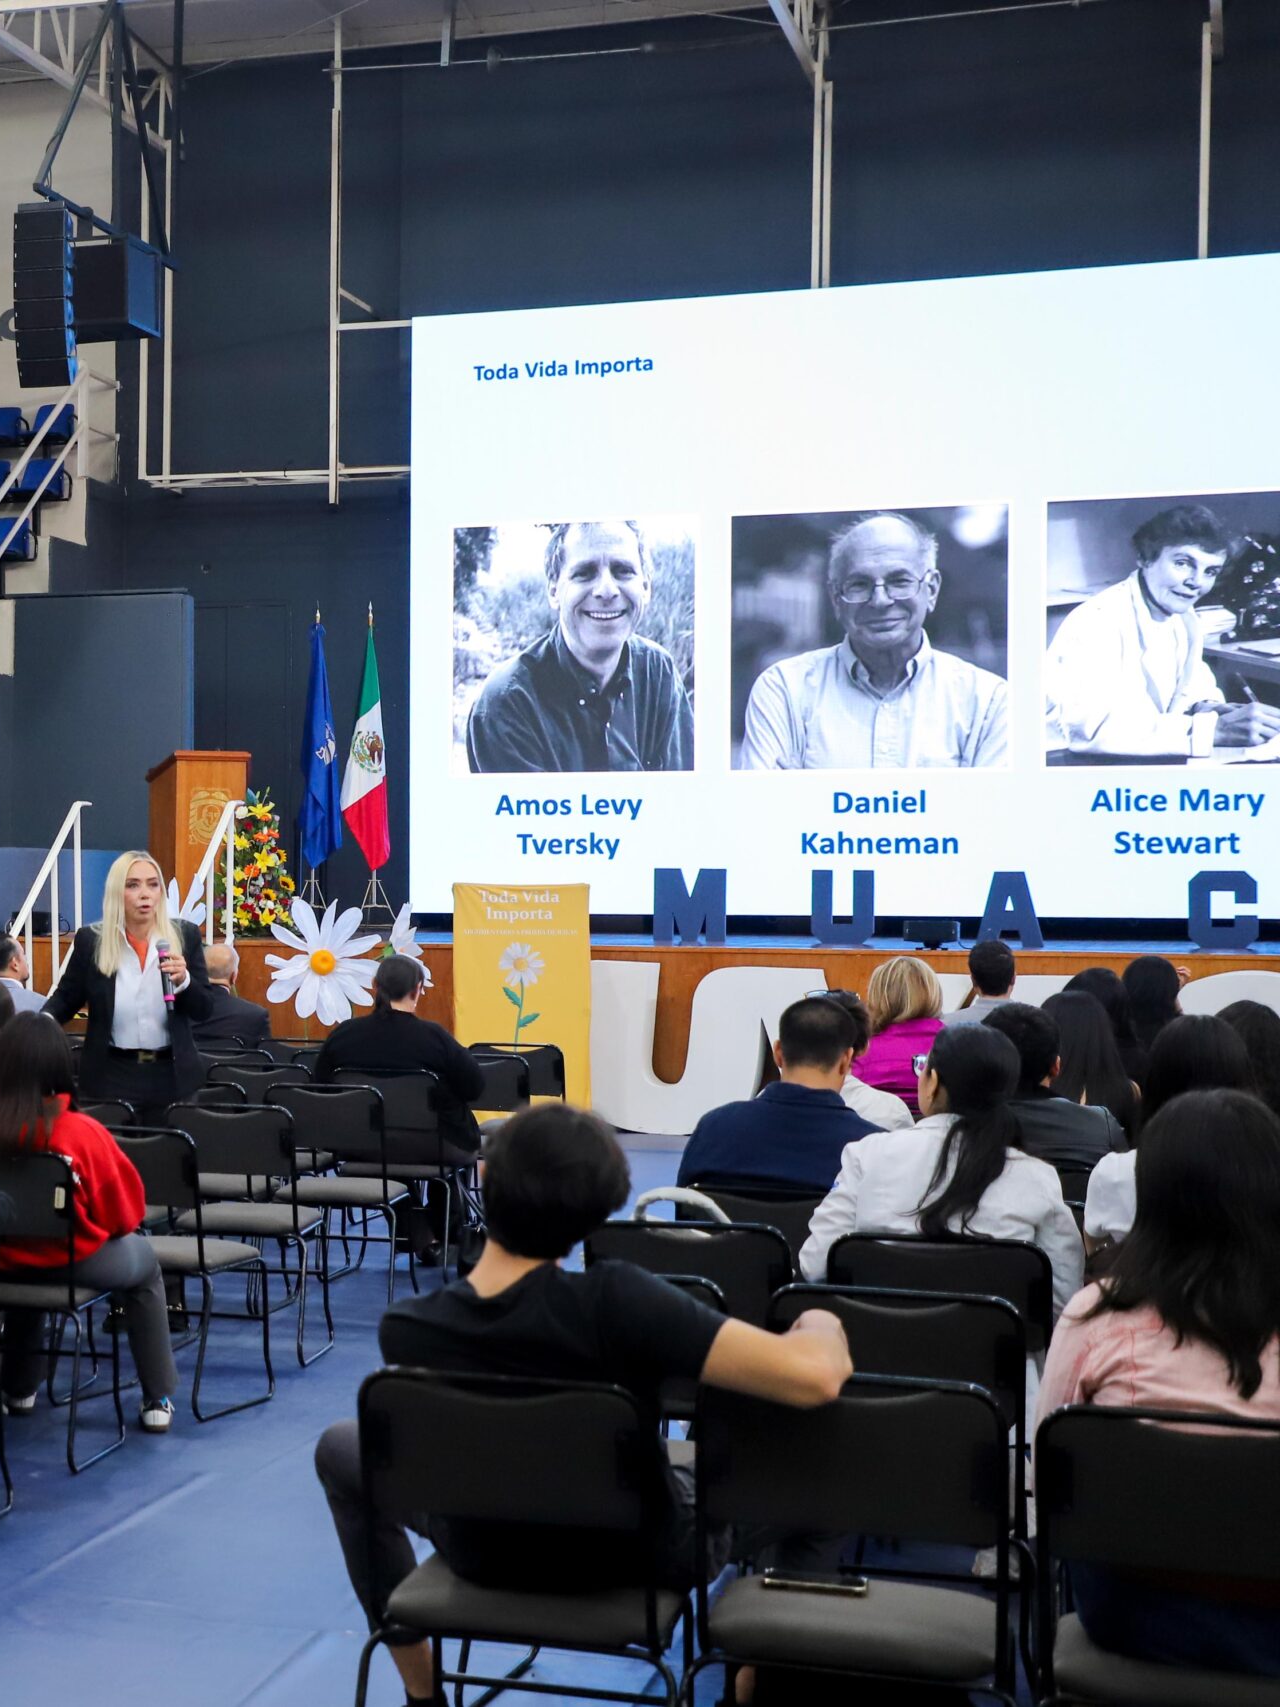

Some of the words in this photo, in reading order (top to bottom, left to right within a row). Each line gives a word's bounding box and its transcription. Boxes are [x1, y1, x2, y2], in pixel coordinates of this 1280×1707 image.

[473, 363, 519, 381] Toda
[525, 360, 568, 378] Vida
[575, 357, 654, 377] Importa
[495, 795, 571, 816] Amos
[581, 794, 643, 820] Levy
[833, 790, 926, 813] Daniel
[1090, 788, 1168, 812] Alice
[1179, 789, 1266, 817] Mary
[516, 832, 620, 860] Tversky
[801, 831, 959, 854] Kahneman
[1114, 831, 1240, 854] Stewart
[479, 890, 517, 903] Toda
[523, 890, 559, 903] Vida
[486, 906, 552, 923] Importa
